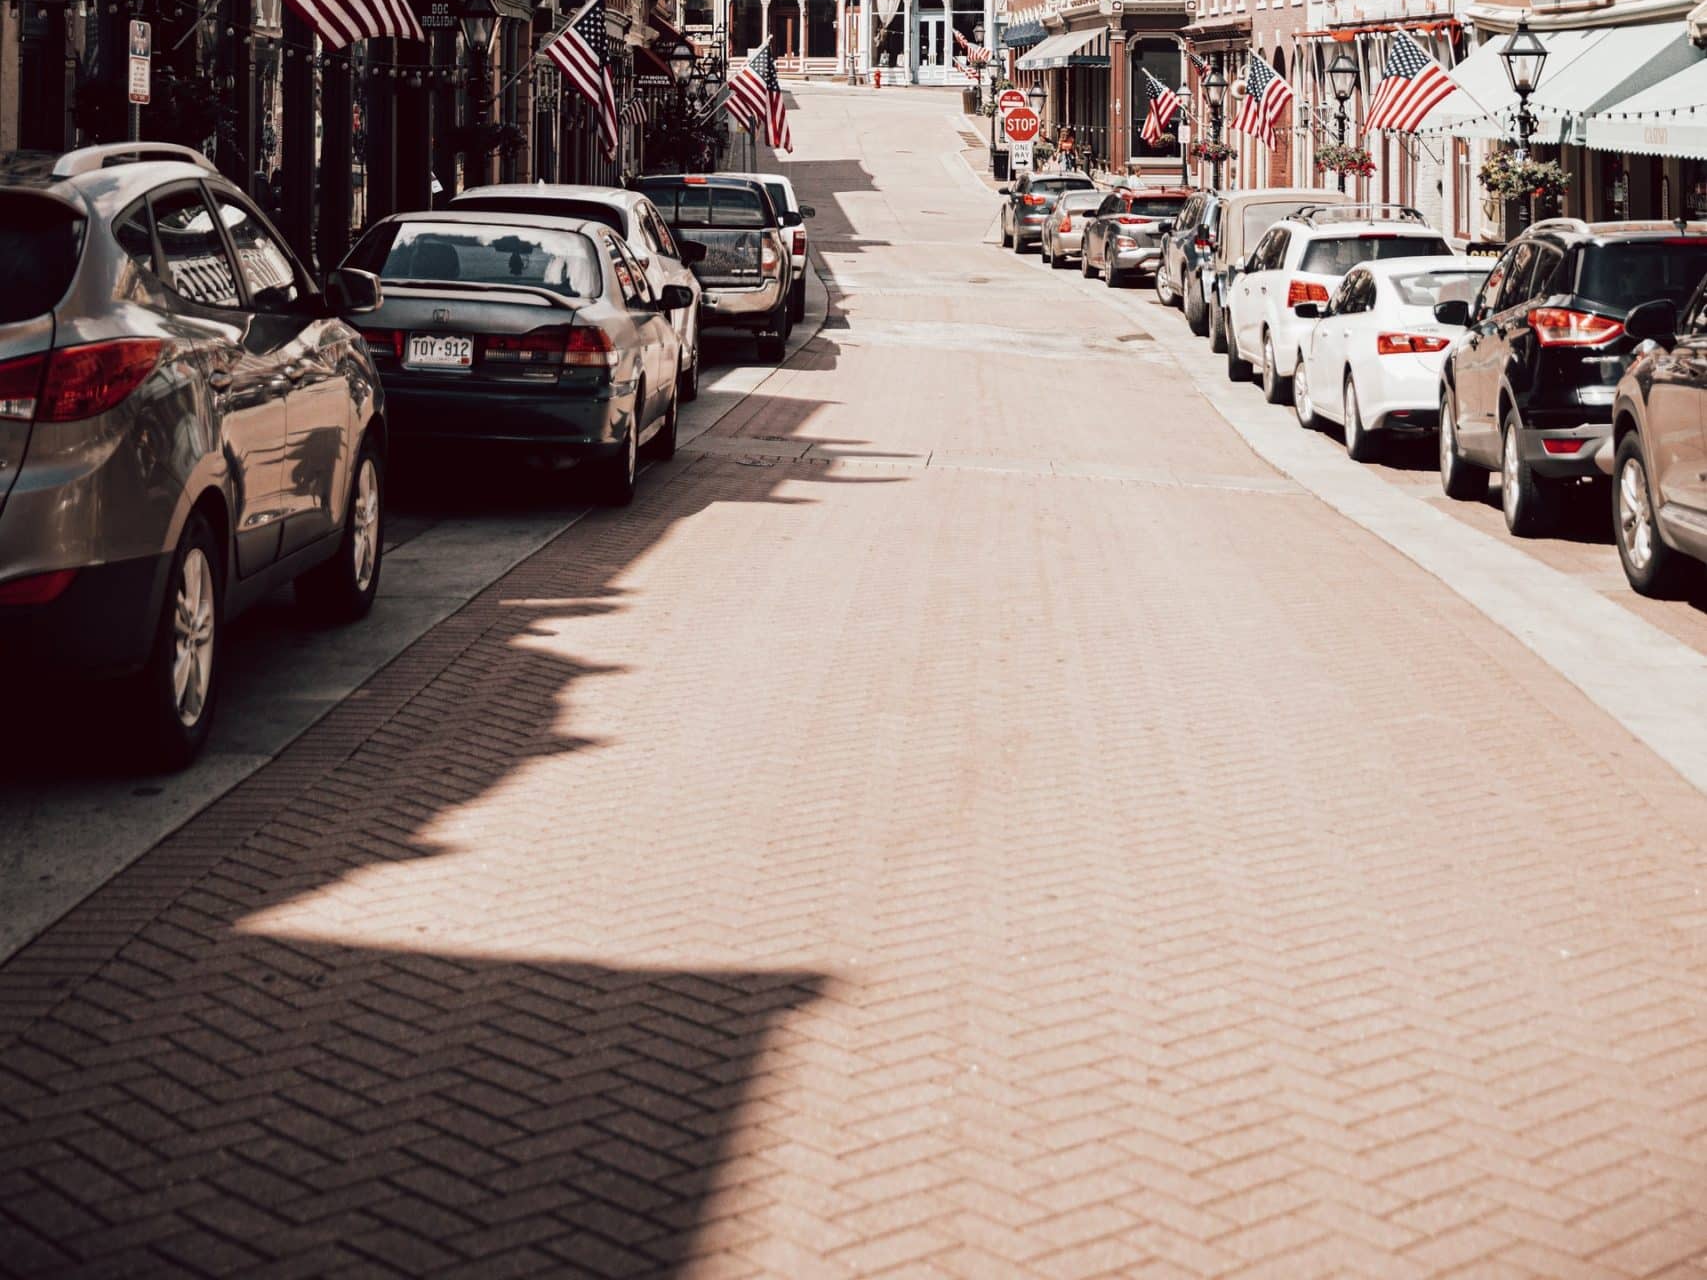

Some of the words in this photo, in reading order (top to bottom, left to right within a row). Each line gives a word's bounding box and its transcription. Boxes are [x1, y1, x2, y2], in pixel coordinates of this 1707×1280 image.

[431, 3, 449, 15] DOC
[1007, 118, 1037, 132] STOP
[1014, 151, 1030, 159] WAY
